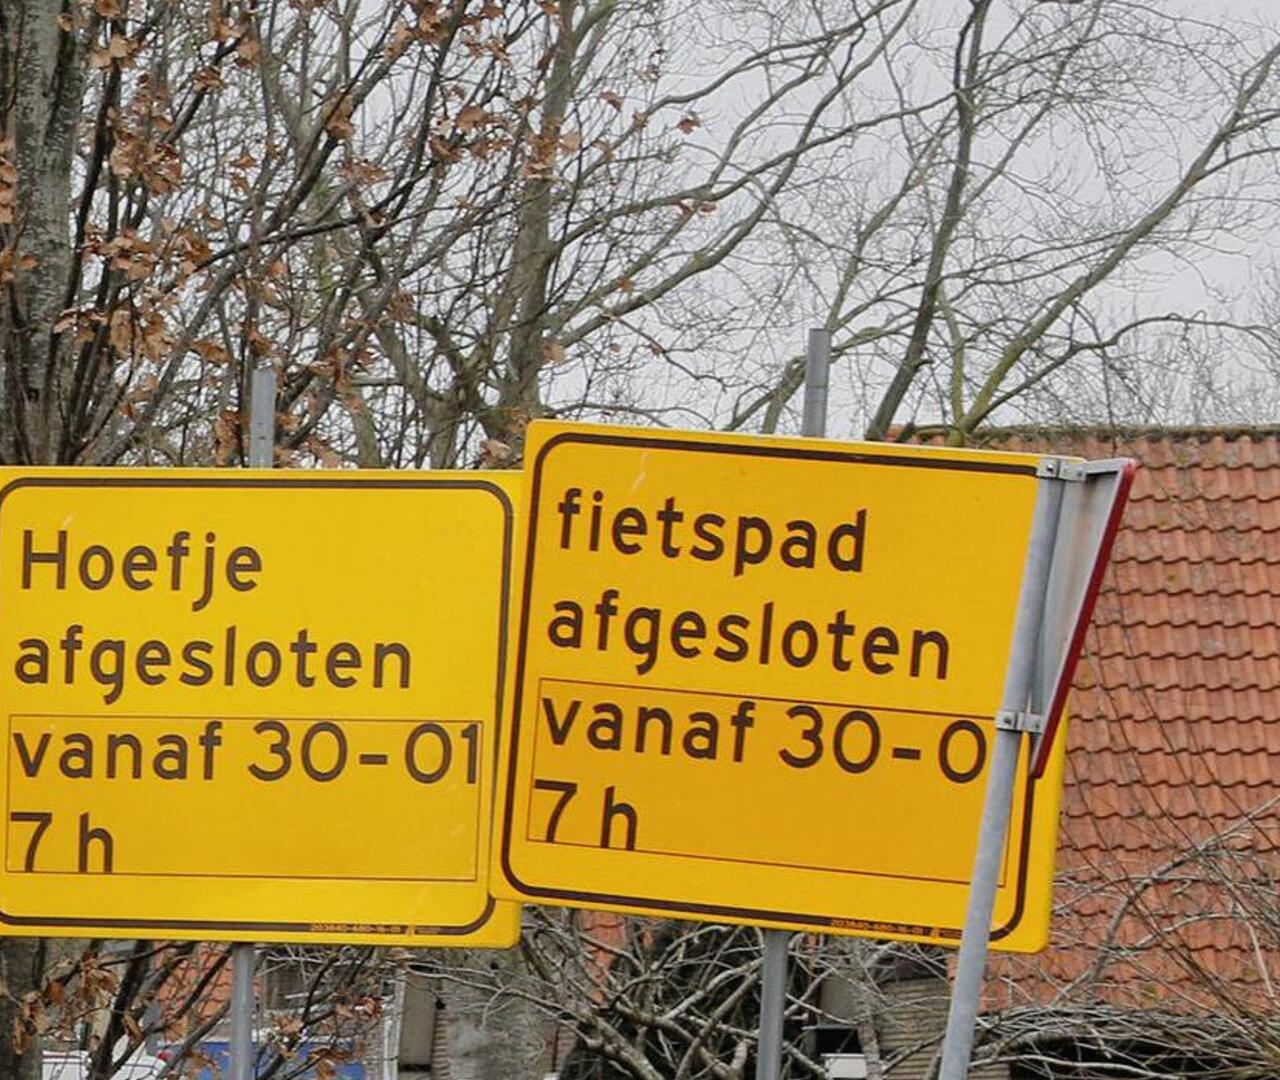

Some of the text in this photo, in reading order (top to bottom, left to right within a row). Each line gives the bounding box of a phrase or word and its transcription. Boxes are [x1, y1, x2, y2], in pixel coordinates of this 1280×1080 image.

[21, 529, 263, 612] Hoefje
[557, 488, 867, 577] fietspad
[14, 625, 411, 705] afgesloten
[547, 589, 950, 680] afgesloten
[13, 721, 479, 785] vanaf 30-01
[542, 696, 987, 784] vanaf 30-0
[10, 811, 114, 873] 7 h
[534, 779, 639, 850] 7 h
